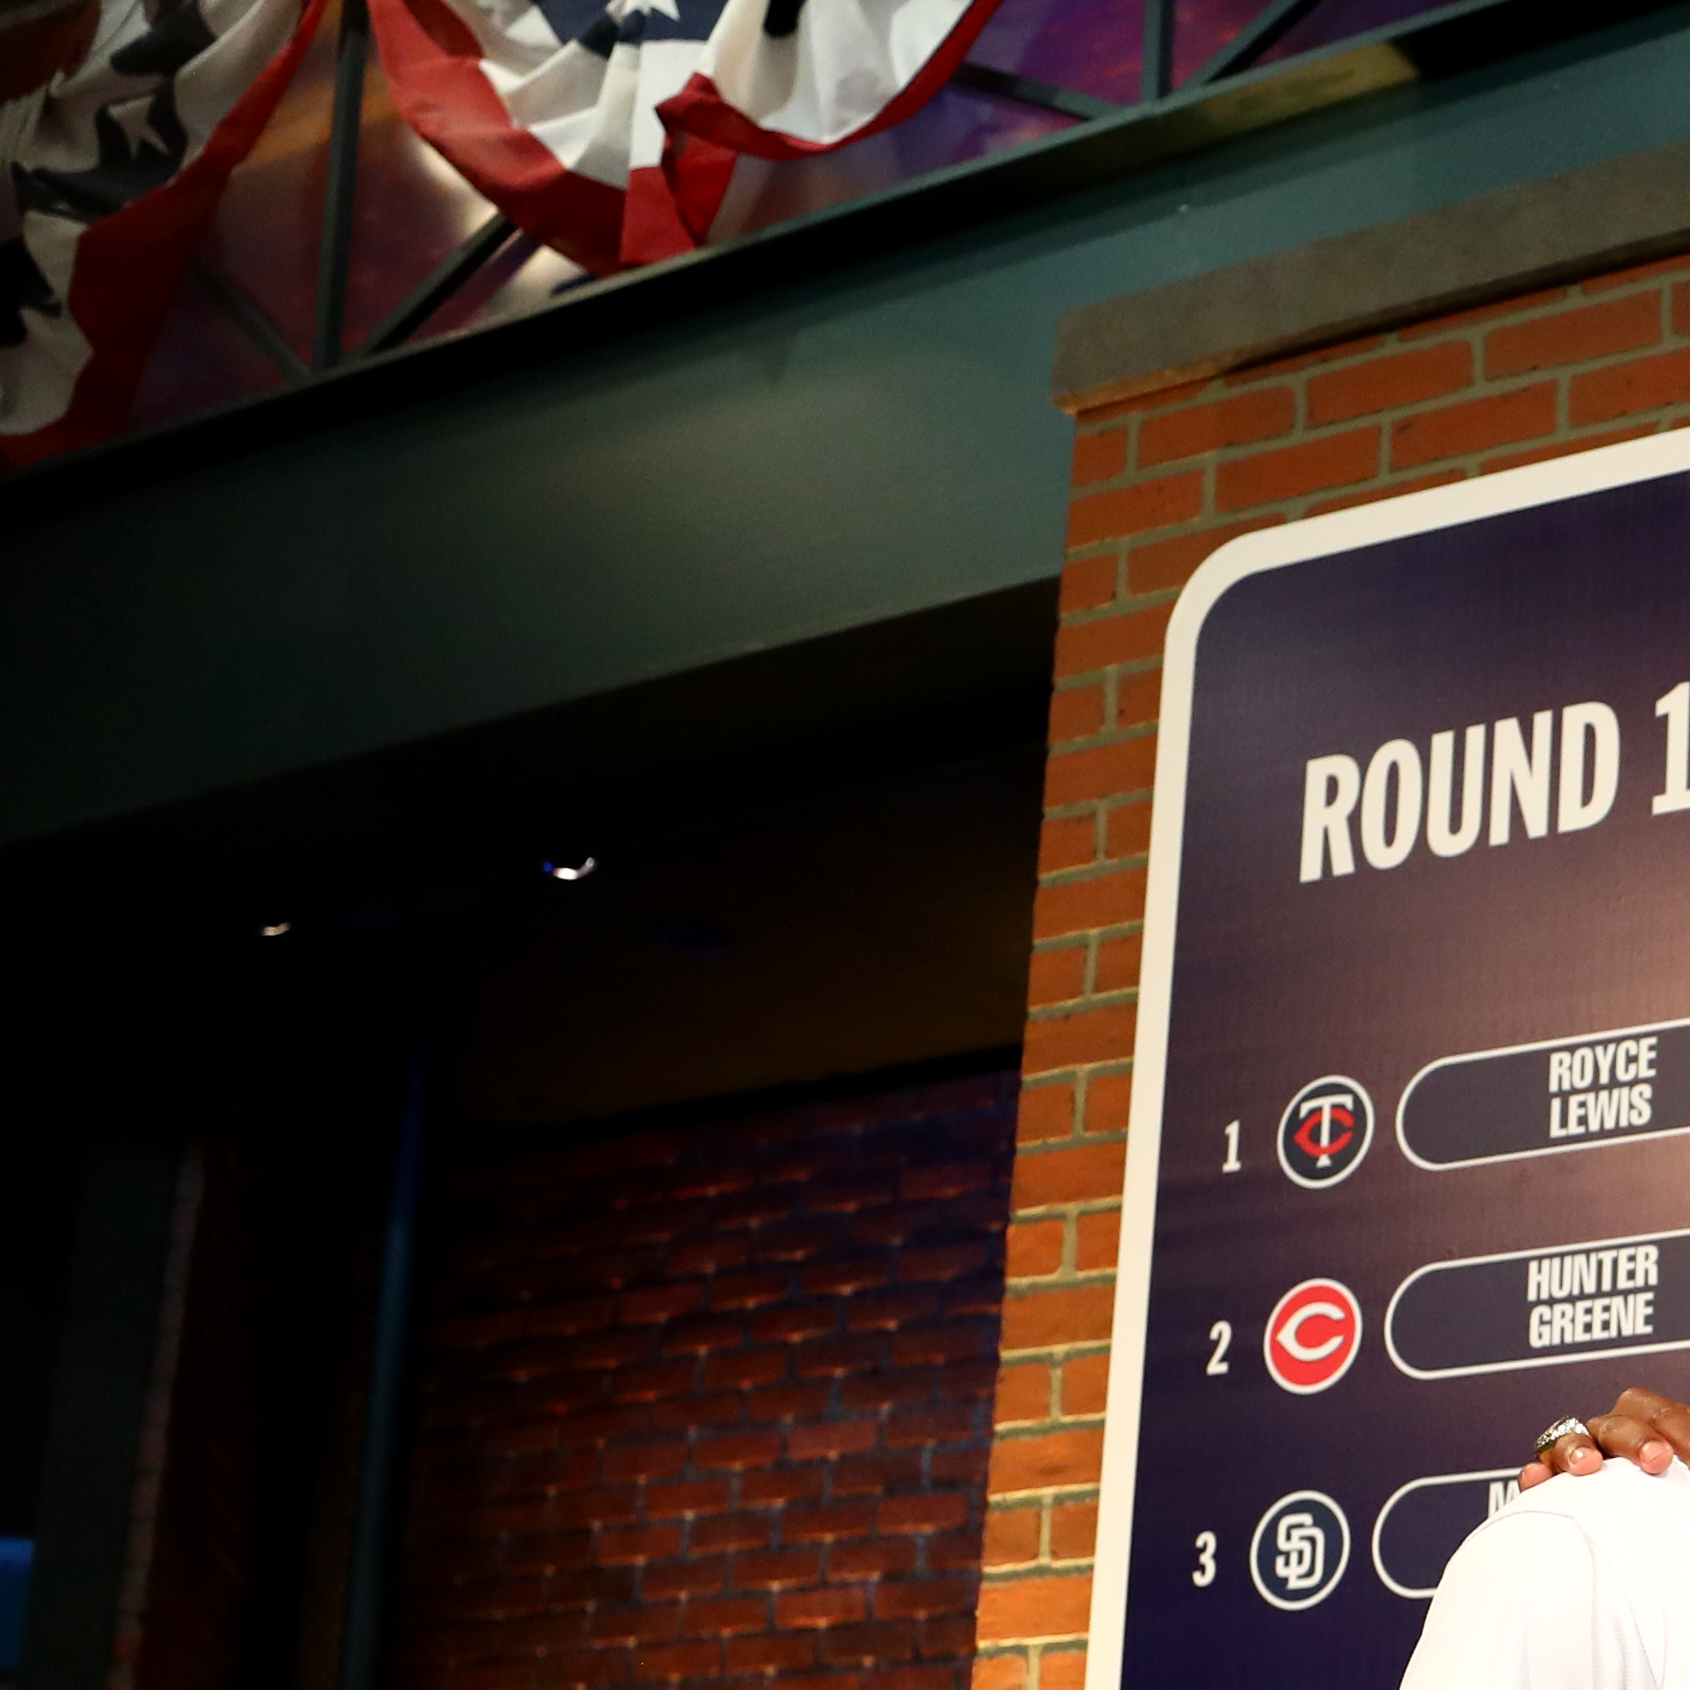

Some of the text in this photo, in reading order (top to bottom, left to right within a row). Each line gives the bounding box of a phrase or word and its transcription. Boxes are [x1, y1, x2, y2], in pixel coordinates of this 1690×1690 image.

[1299, 702, 1620, 883] ROUND
[1549, 1036, 1658, 1093] ROYCE
[1549, 1083, 1653, 1138] LEWIS
[1222, 1120, 1242, 1173] 1
[1527, 1244, 1659, 1302] HUNTER
[1529, 1291, 1655, 1348] GREENE
[1206, 1321, 1232, 1375] 2
[1192, 1531, 1217, 1587] 3
